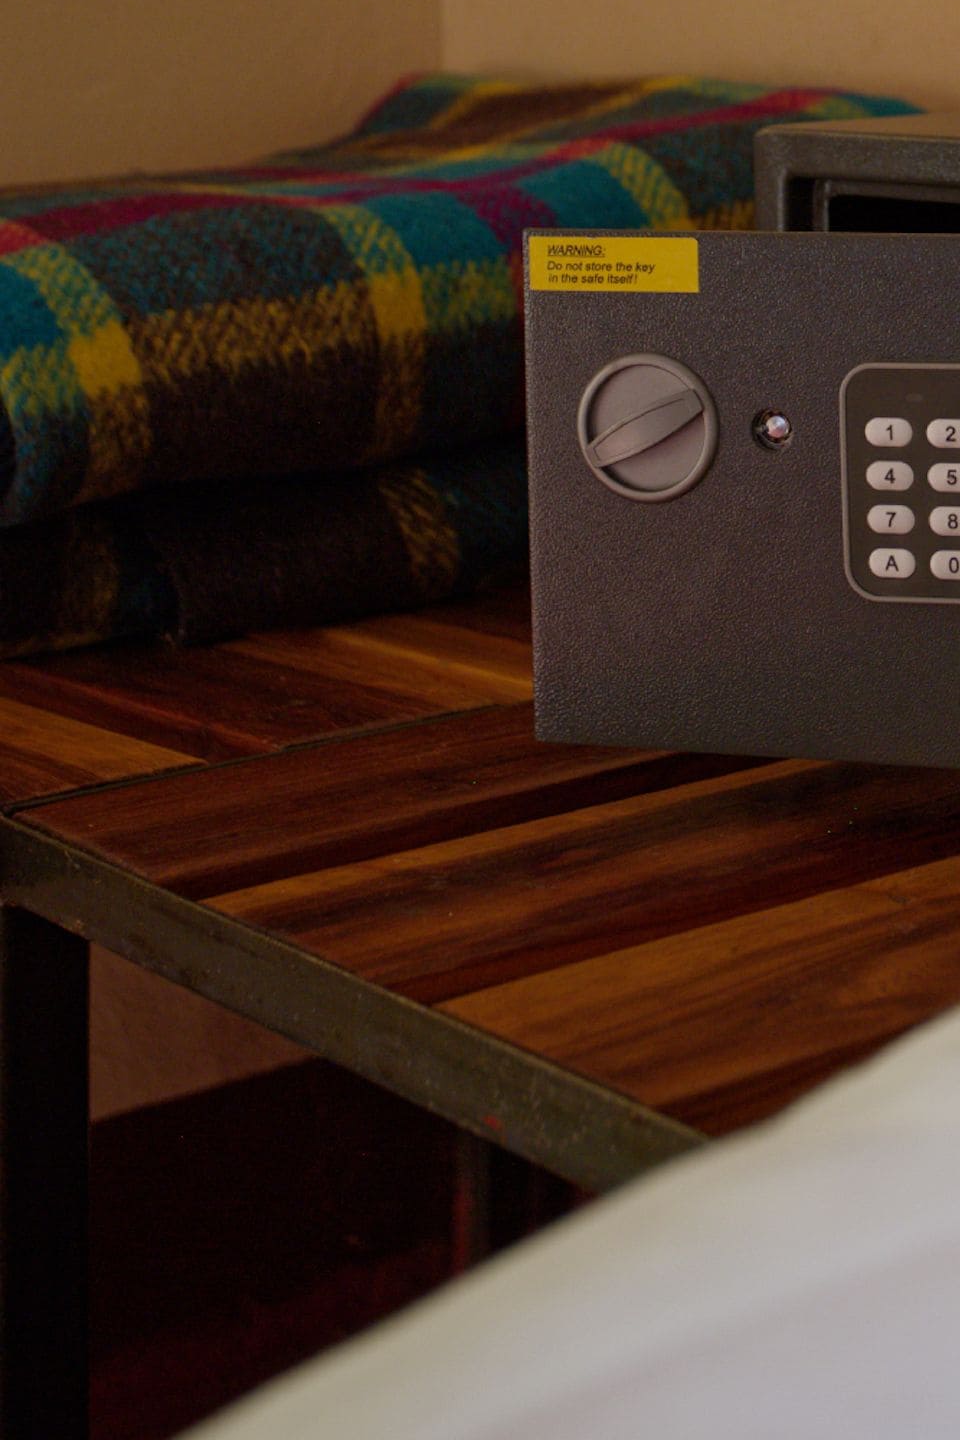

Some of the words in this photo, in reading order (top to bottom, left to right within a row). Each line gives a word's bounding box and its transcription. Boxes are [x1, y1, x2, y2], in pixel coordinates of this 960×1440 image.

[547, 245, 605, 256] WARNING:
[547, 261, 562, 271] Do
[565, 262, 582, 271] not
[585, 263, 612, 272] store
[616, 262, 632, 272] the
[636, 263, 656, 274] key
[548, 274, 558, 283] in
[561, 274, 578, 283] the
[582, 274, 604, 284] safe
[885, 425, 894, 440] 1
[946, 426, 956, 442] 2
[884, 469, 895, 484] 4
[947, 470, 957, 485] 5
[887, 512, 896, 527] 7
[948, 514, 958, 529] 8
[886, 556, 899, 572] A
[949, 558, 959, 573] 0
